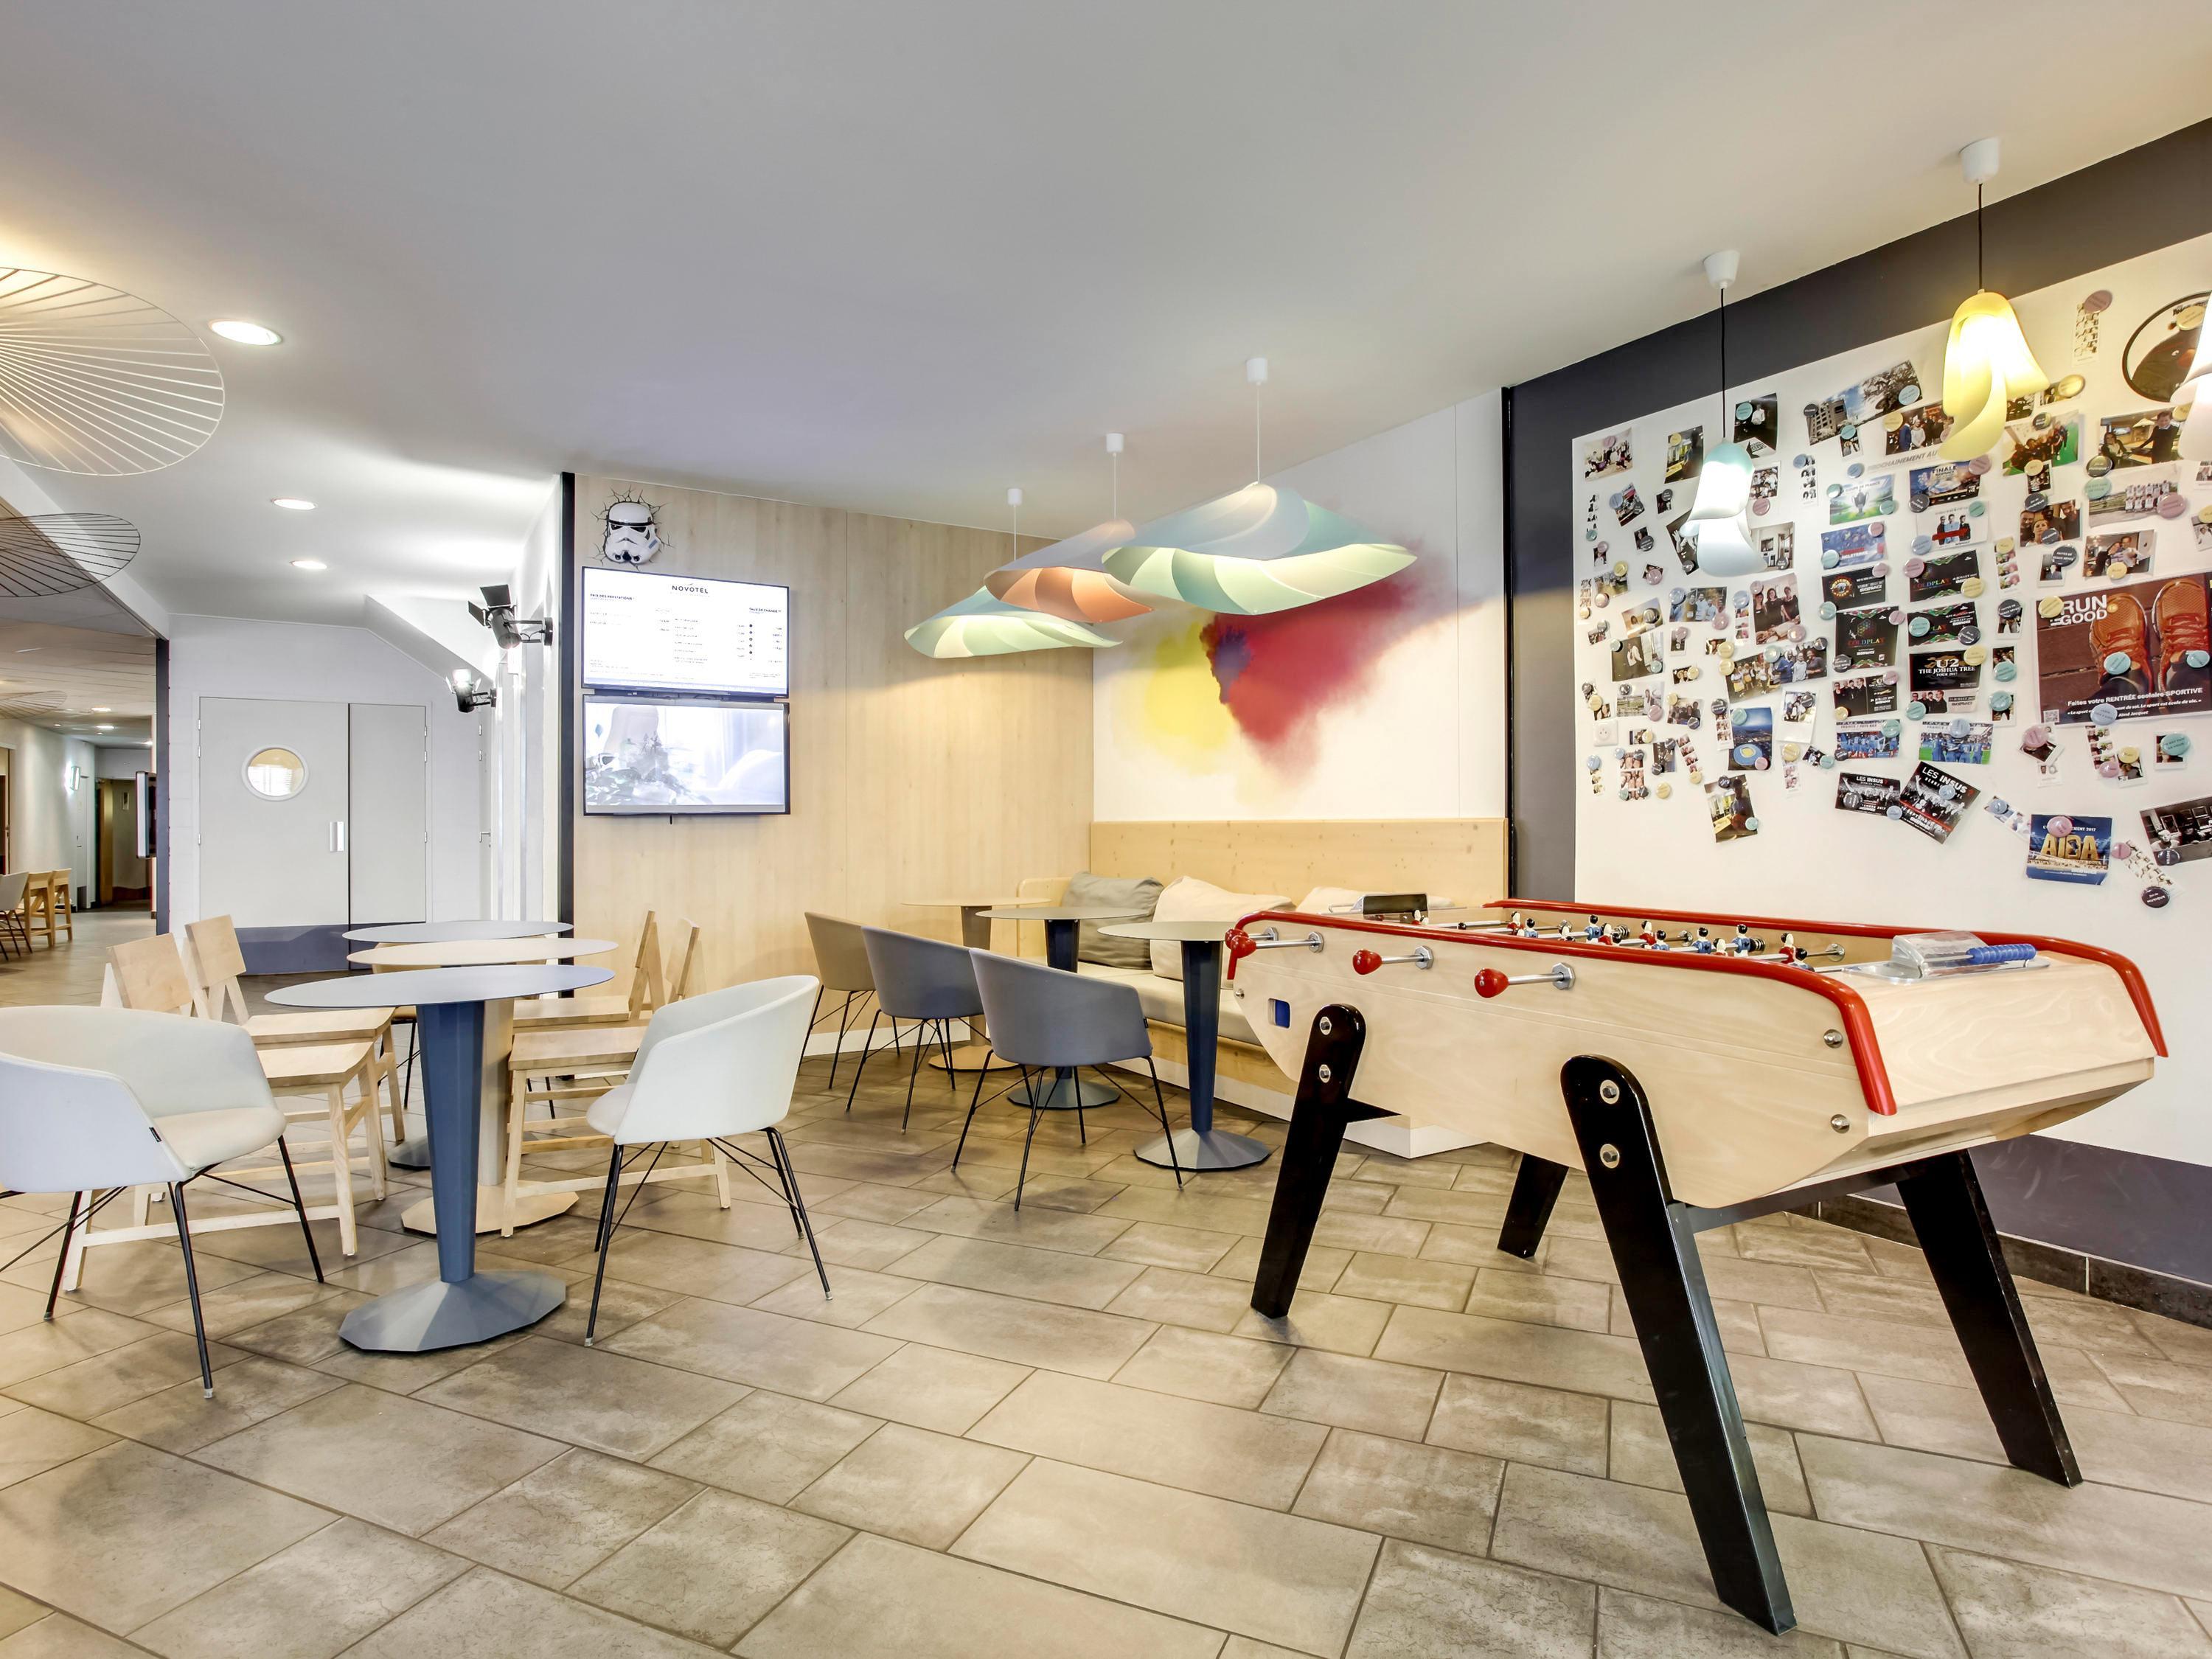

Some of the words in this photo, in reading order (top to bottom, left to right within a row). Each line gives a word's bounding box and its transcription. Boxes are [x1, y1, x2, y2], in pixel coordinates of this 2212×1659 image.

[672, 585, 709, 594] NOVOTEL
[2061, 594, 2107, 616] RUN
[2062, 609, 2107, 626] GOOD
[1848, 637, 1886, 647] COLDPLAY
[1935, 658, 1959, 668] U2
[2106, 694, 2137, 703] RENTRÉE
[2166, 687, 2203, 696] SPORTIVE
[1922, 767, 1939, 779] LES
[1939, 775, 1968, 793] INSUS
[2040, 833, 2099, 861] AIDA
